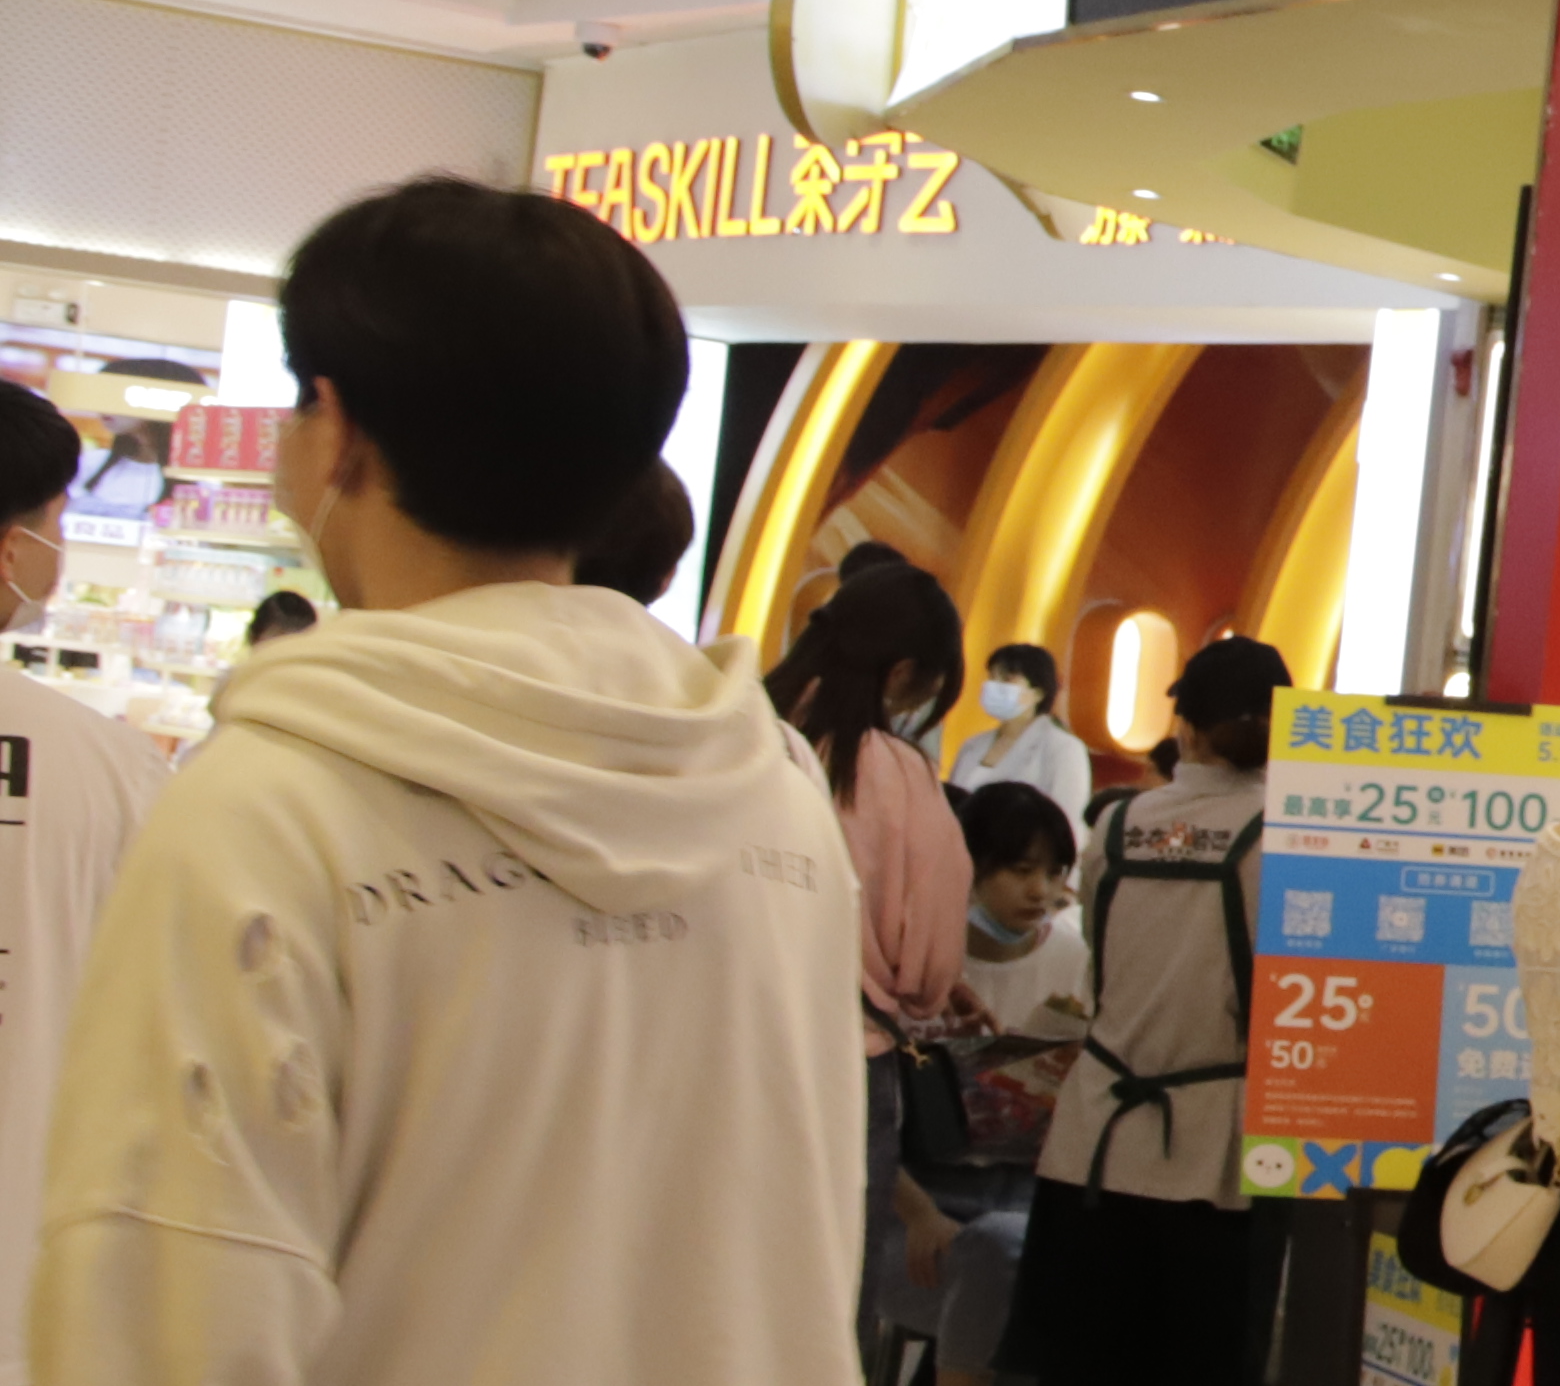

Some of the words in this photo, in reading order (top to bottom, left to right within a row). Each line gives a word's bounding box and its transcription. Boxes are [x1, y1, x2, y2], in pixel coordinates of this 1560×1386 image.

[1289, 704, 1484, 760] 美食狂欢
[1284, 794, 1352, 821] 最高享
